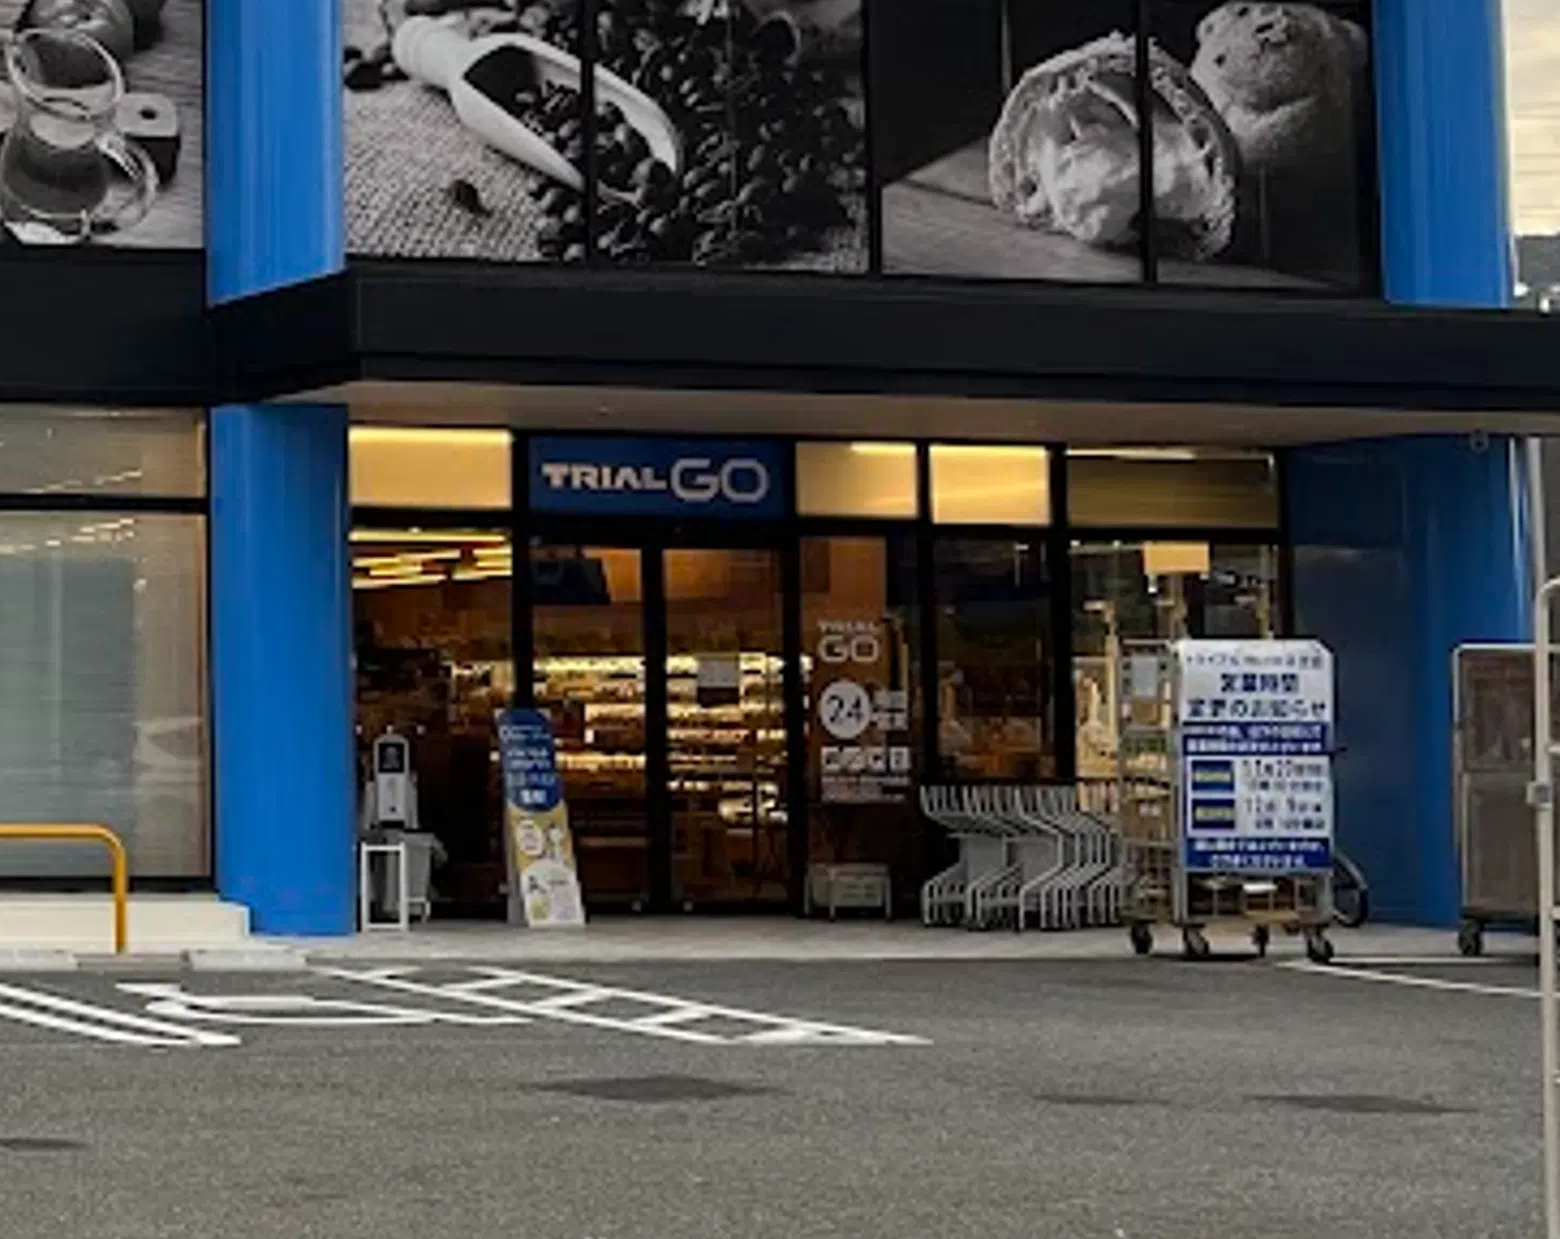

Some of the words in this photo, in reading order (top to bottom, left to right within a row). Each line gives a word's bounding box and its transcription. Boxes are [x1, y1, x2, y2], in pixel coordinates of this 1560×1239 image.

[541, 462, 668, 490] TRIAL
[670, 458, 770, 503] GO
[818, 634, 878, 663] GO
[827, 694, 866, 724] 24
